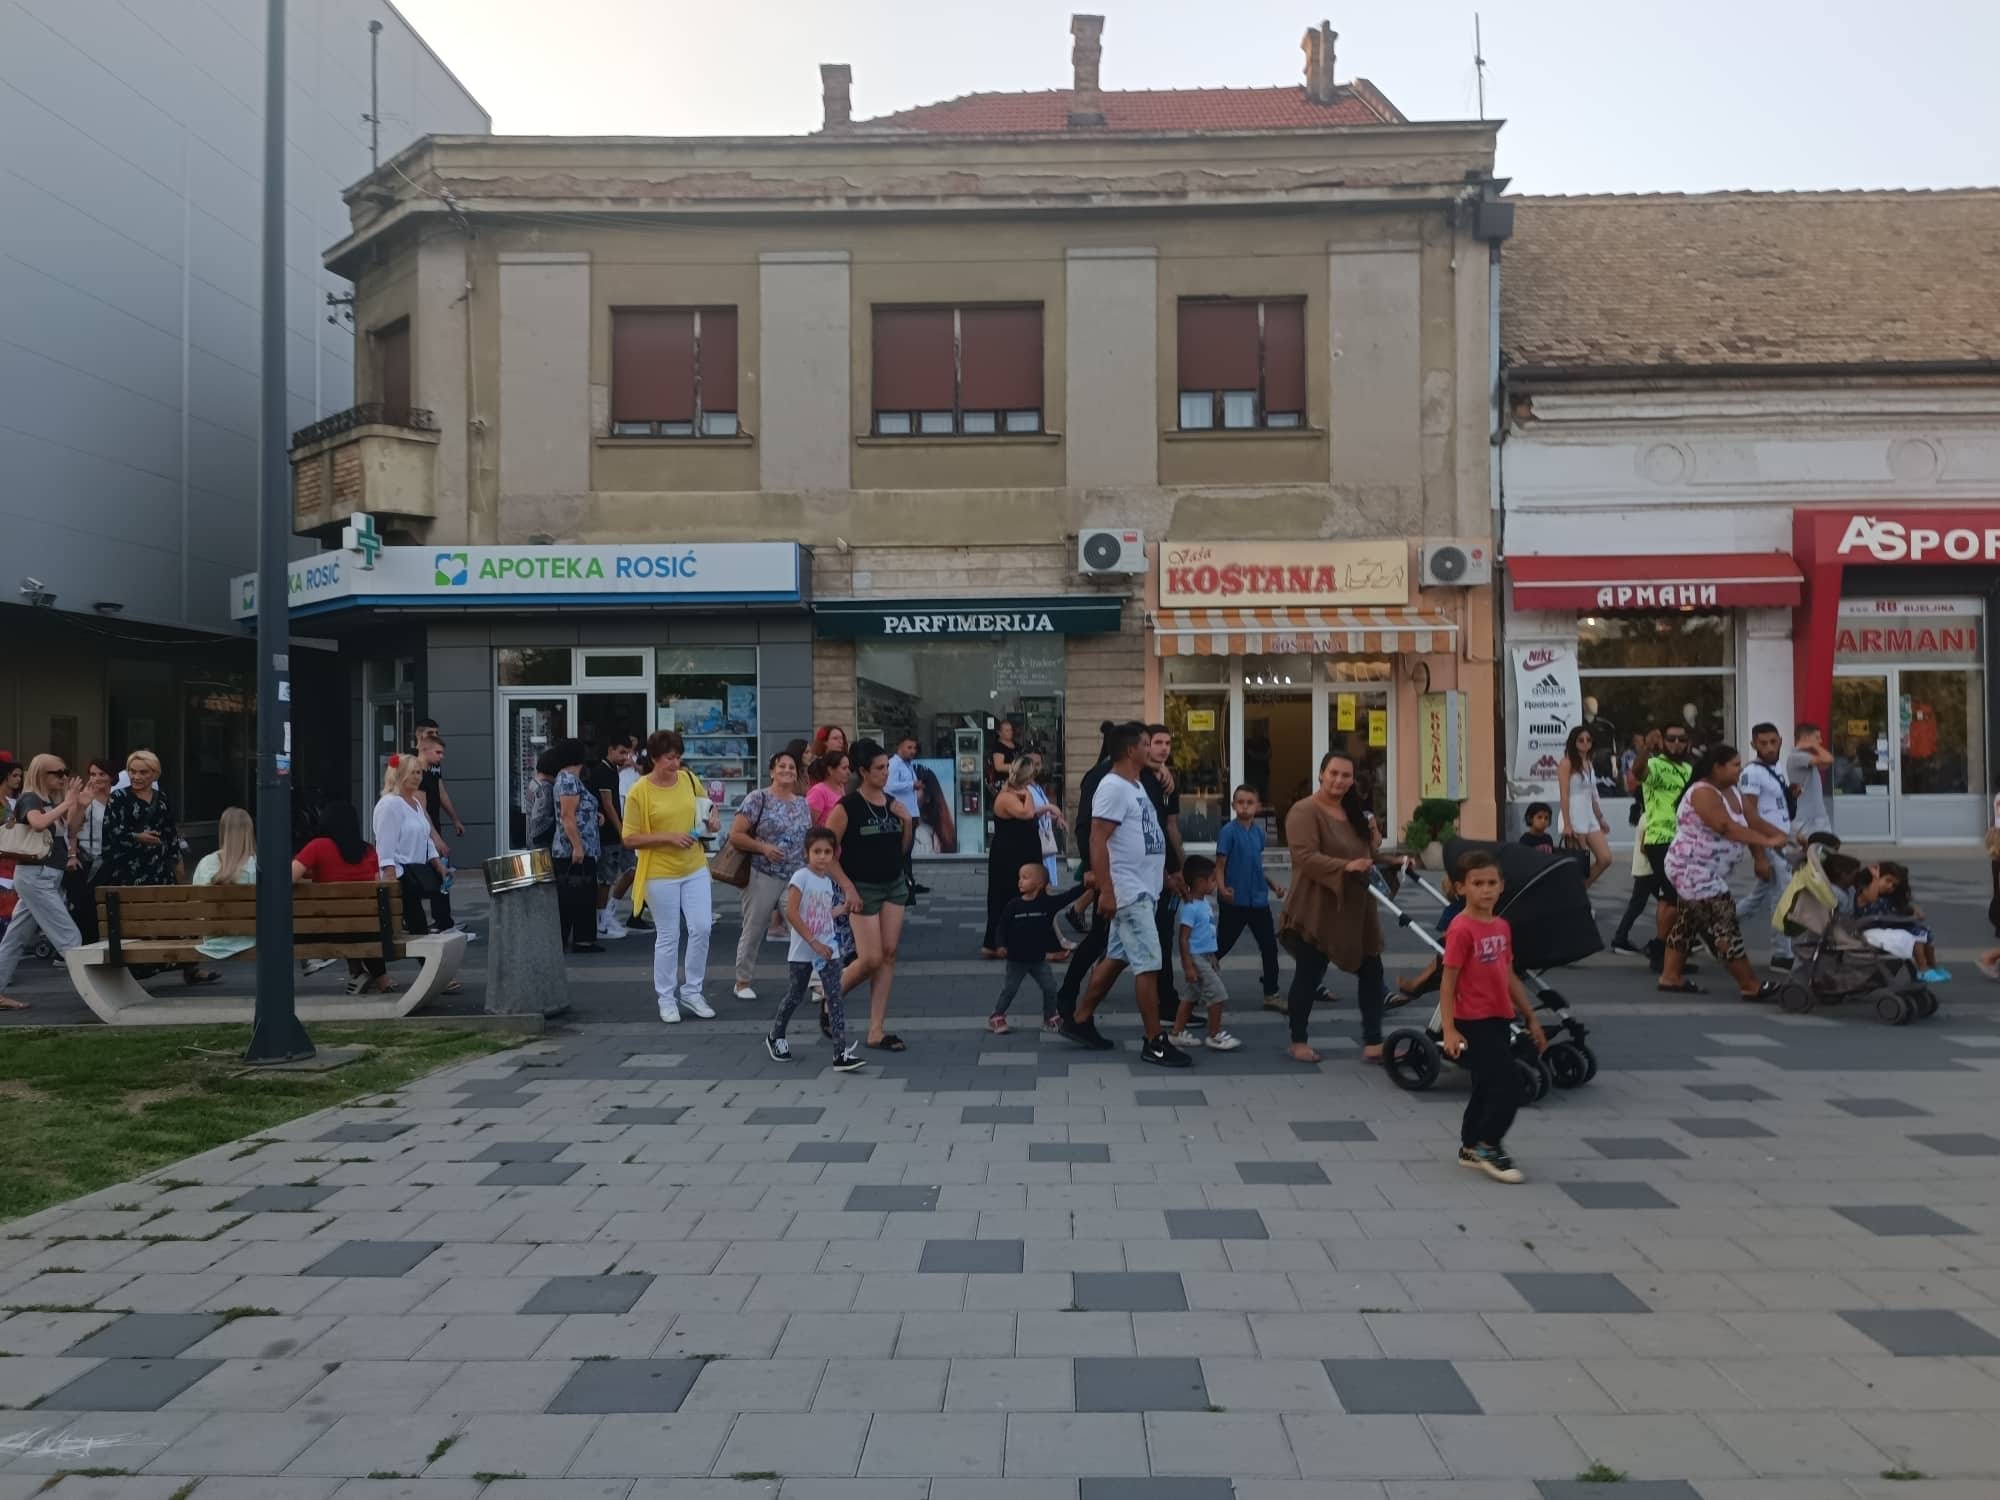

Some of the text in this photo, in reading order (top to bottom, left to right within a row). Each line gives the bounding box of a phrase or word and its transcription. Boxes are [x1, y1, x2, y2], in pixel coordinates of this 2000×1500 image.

[479, 551, 697, 579] APOTEKA ROSIĆ
[1597, 584, 1717, 608] АРМАНИ
[884, 613, 1055, 634] PARFIMERIJA
[1836, 627, 1977, 653] ARMANI
